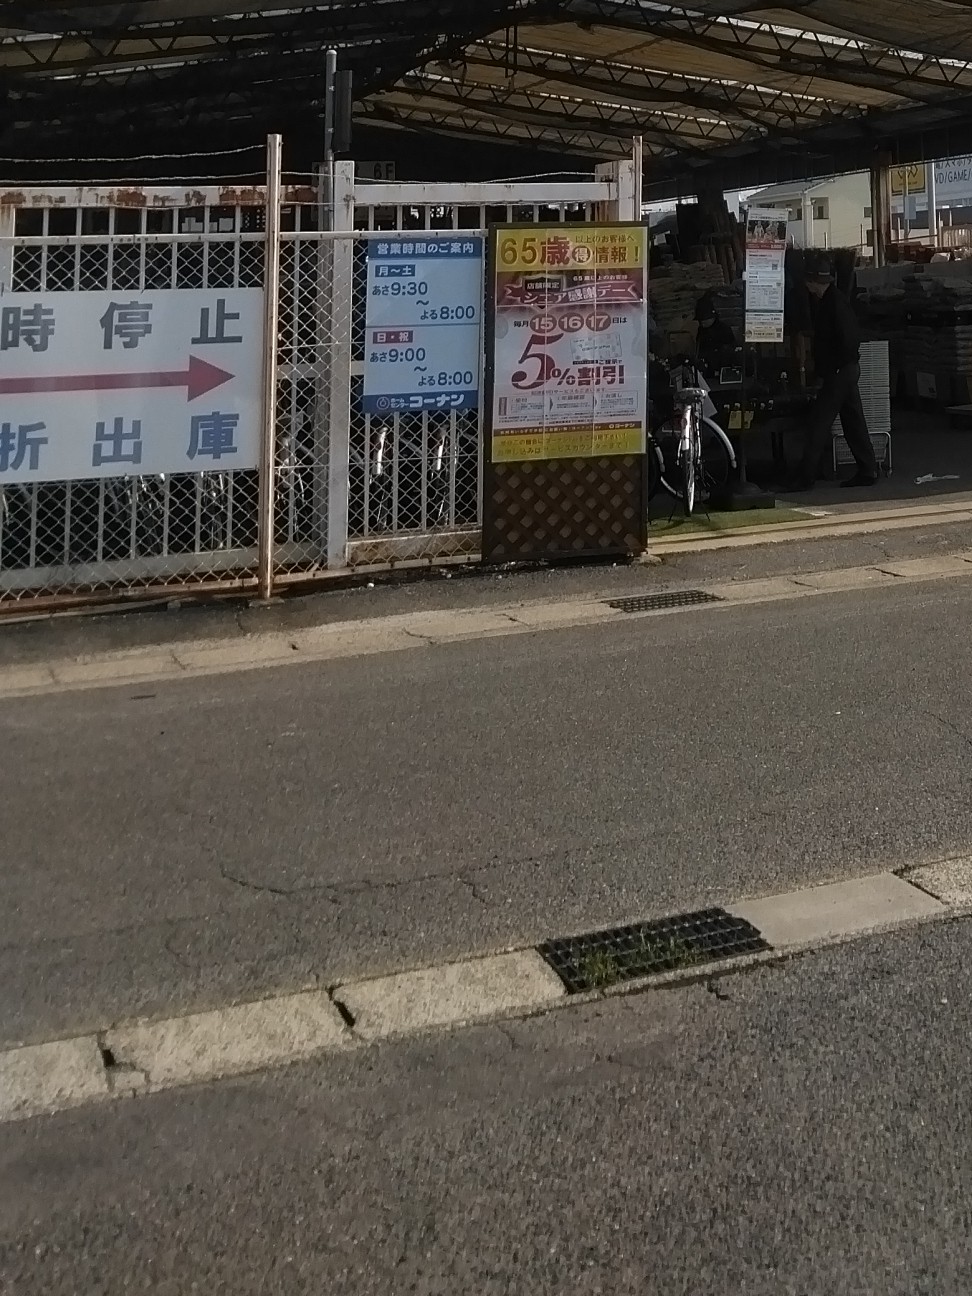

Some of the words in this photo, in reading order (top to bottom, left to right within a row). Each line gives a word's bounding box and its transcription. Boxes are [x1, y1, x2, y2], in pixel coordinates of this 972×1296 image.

[377, 242, 474, 254] 営業時間のご案内
[524, 284, 626, 304] シニア感謝デー
[409, 394, 465, 408] コーナン
